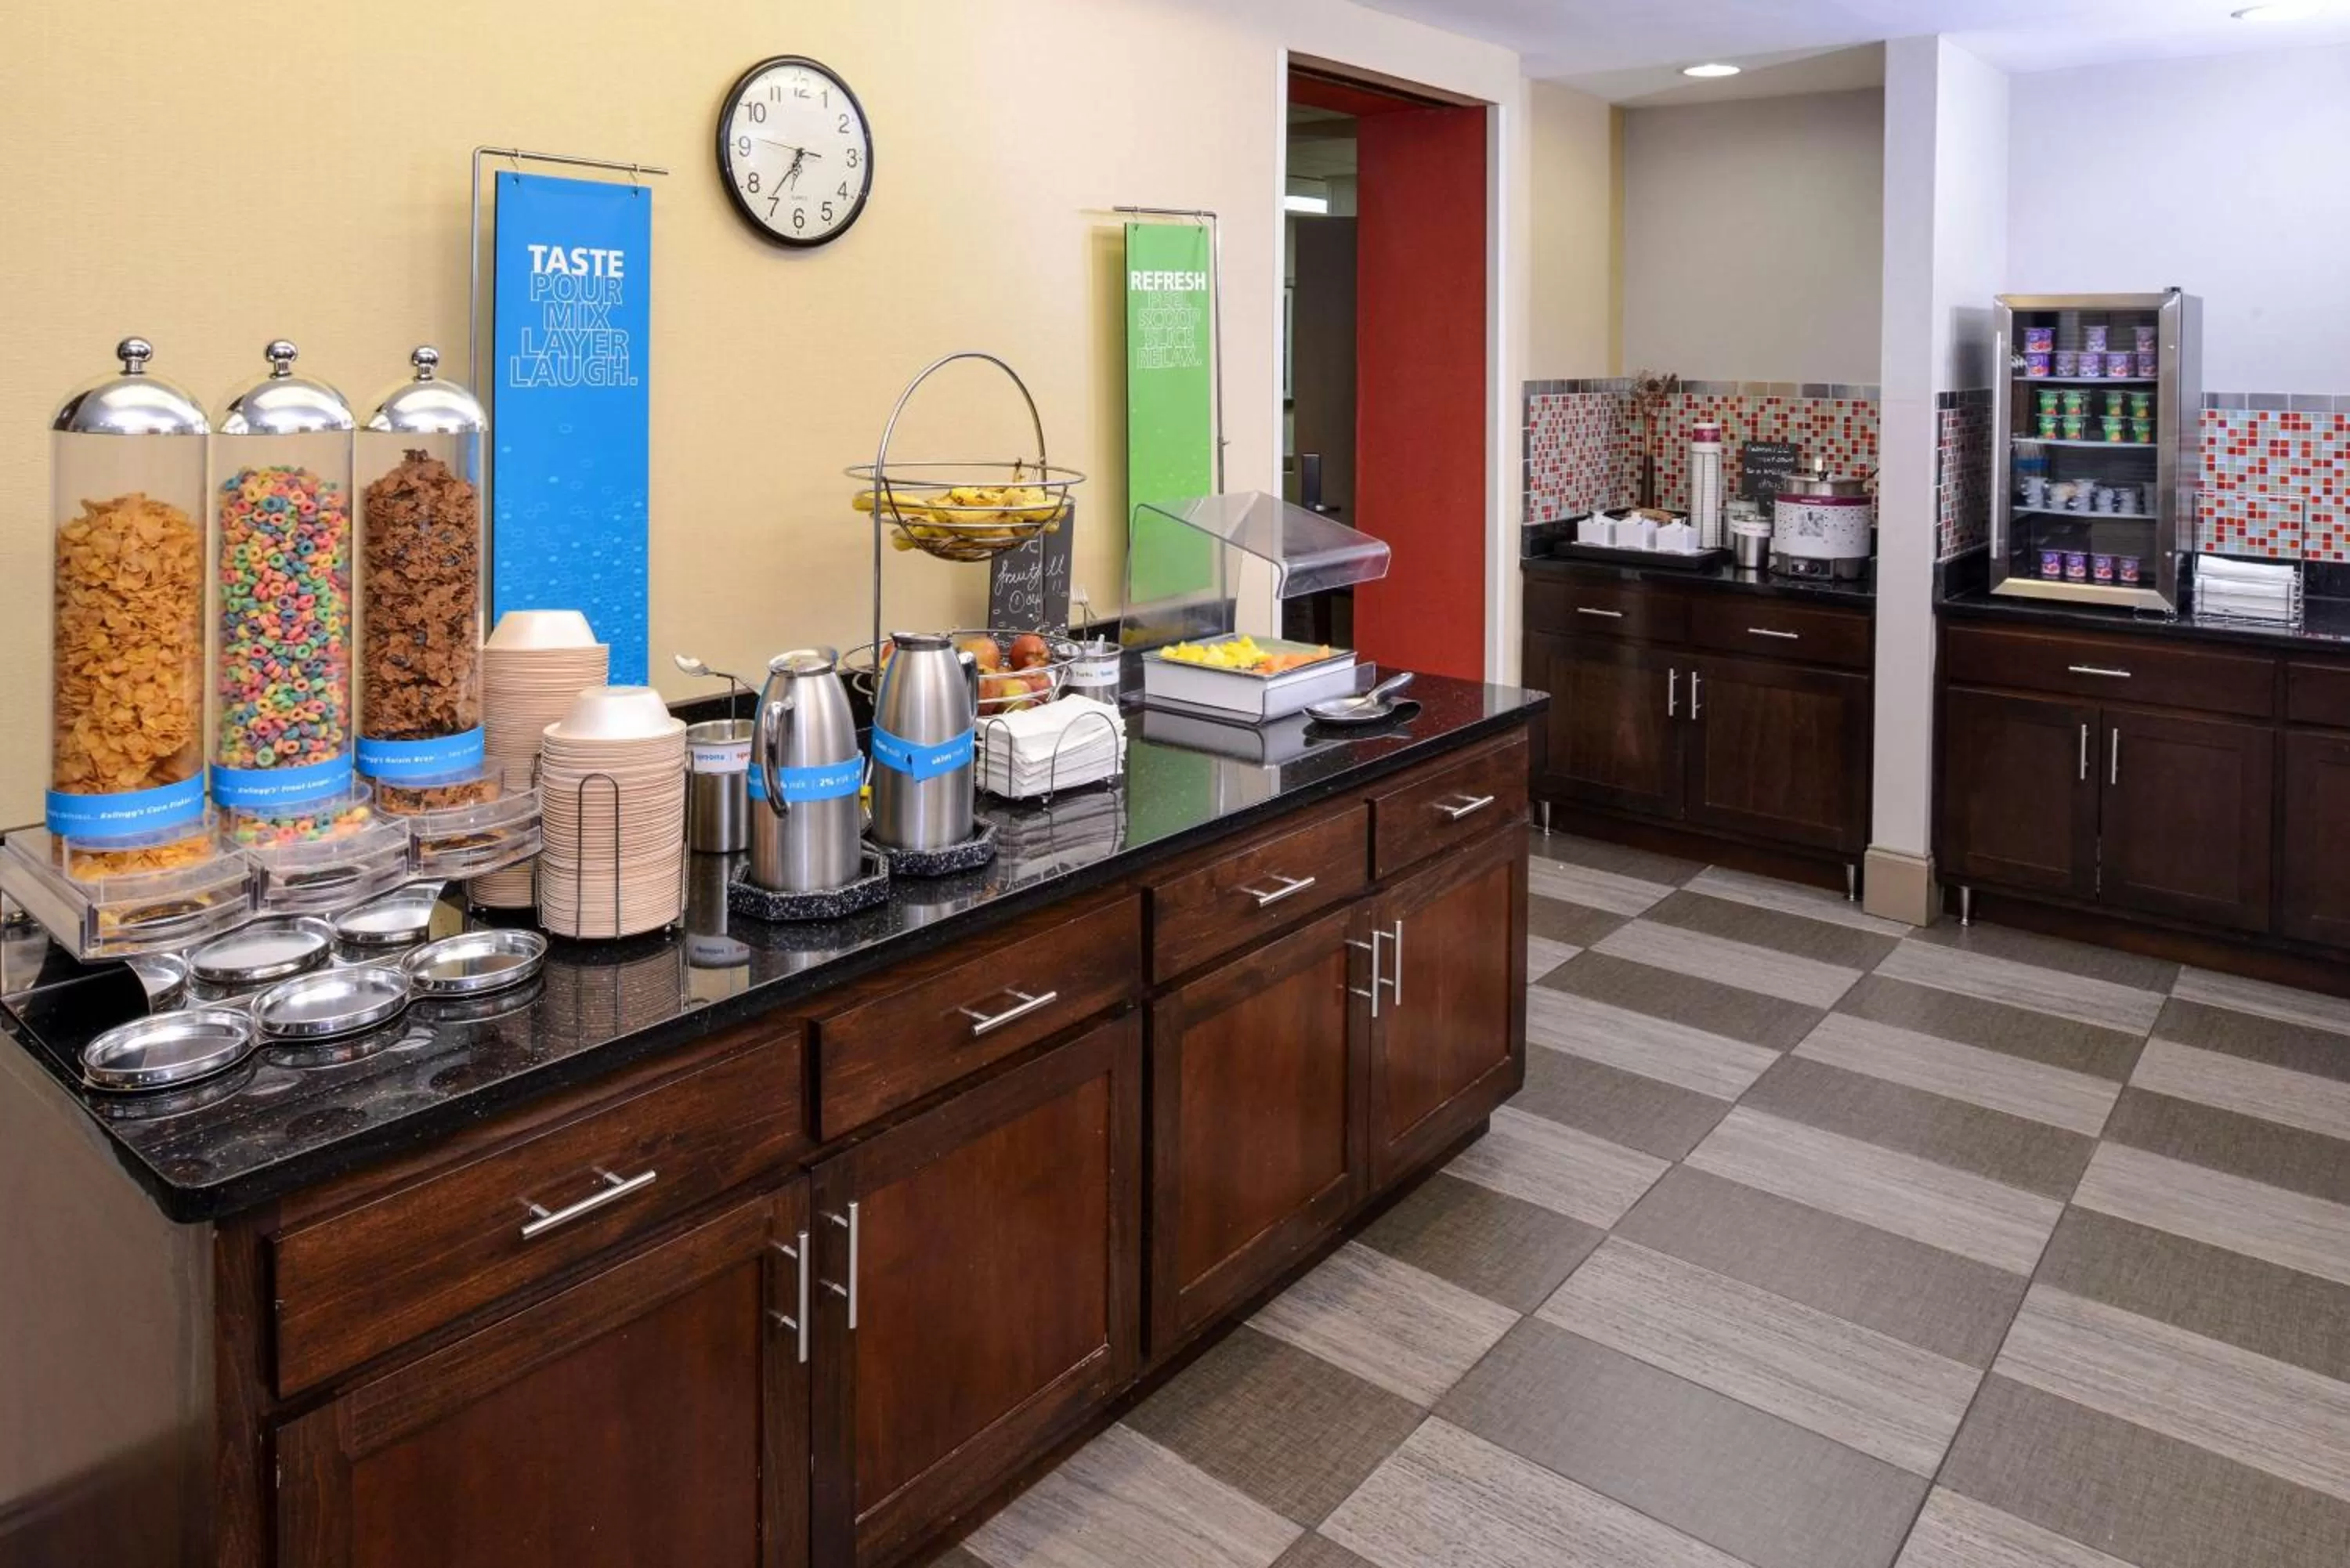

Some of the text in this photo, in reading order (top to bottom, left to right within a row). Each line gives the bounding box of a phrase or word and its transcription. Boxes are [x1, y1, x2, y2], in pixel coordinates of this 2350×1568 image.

[770, 85, 782, 103] 11
[793, 77, 810, 99] 12
[821, 89, 828, 108] 1
[746, 102, 766, 123] 10
[838, 114, 850, 134] 2
[739, 135, 751, 157] 9
[847, 148, 857, 168] 3
[747, 172, 760, 193] 8
[837, 181, 848, 201] 4
[768, 196, 779, 217] 7
[821, 201, 833, 221] 5
[793, 208, 804, 229] 6
[527, 244, 624, 277] TASTE
[530, 271, 624, 305] POUR
[1130, 269, 1206, 291] REFRESH
[543, 300, 612, 331] MIX
[521, 326, 629, 359] LAYER
[510, 355, 638, 387] LAUGH.
